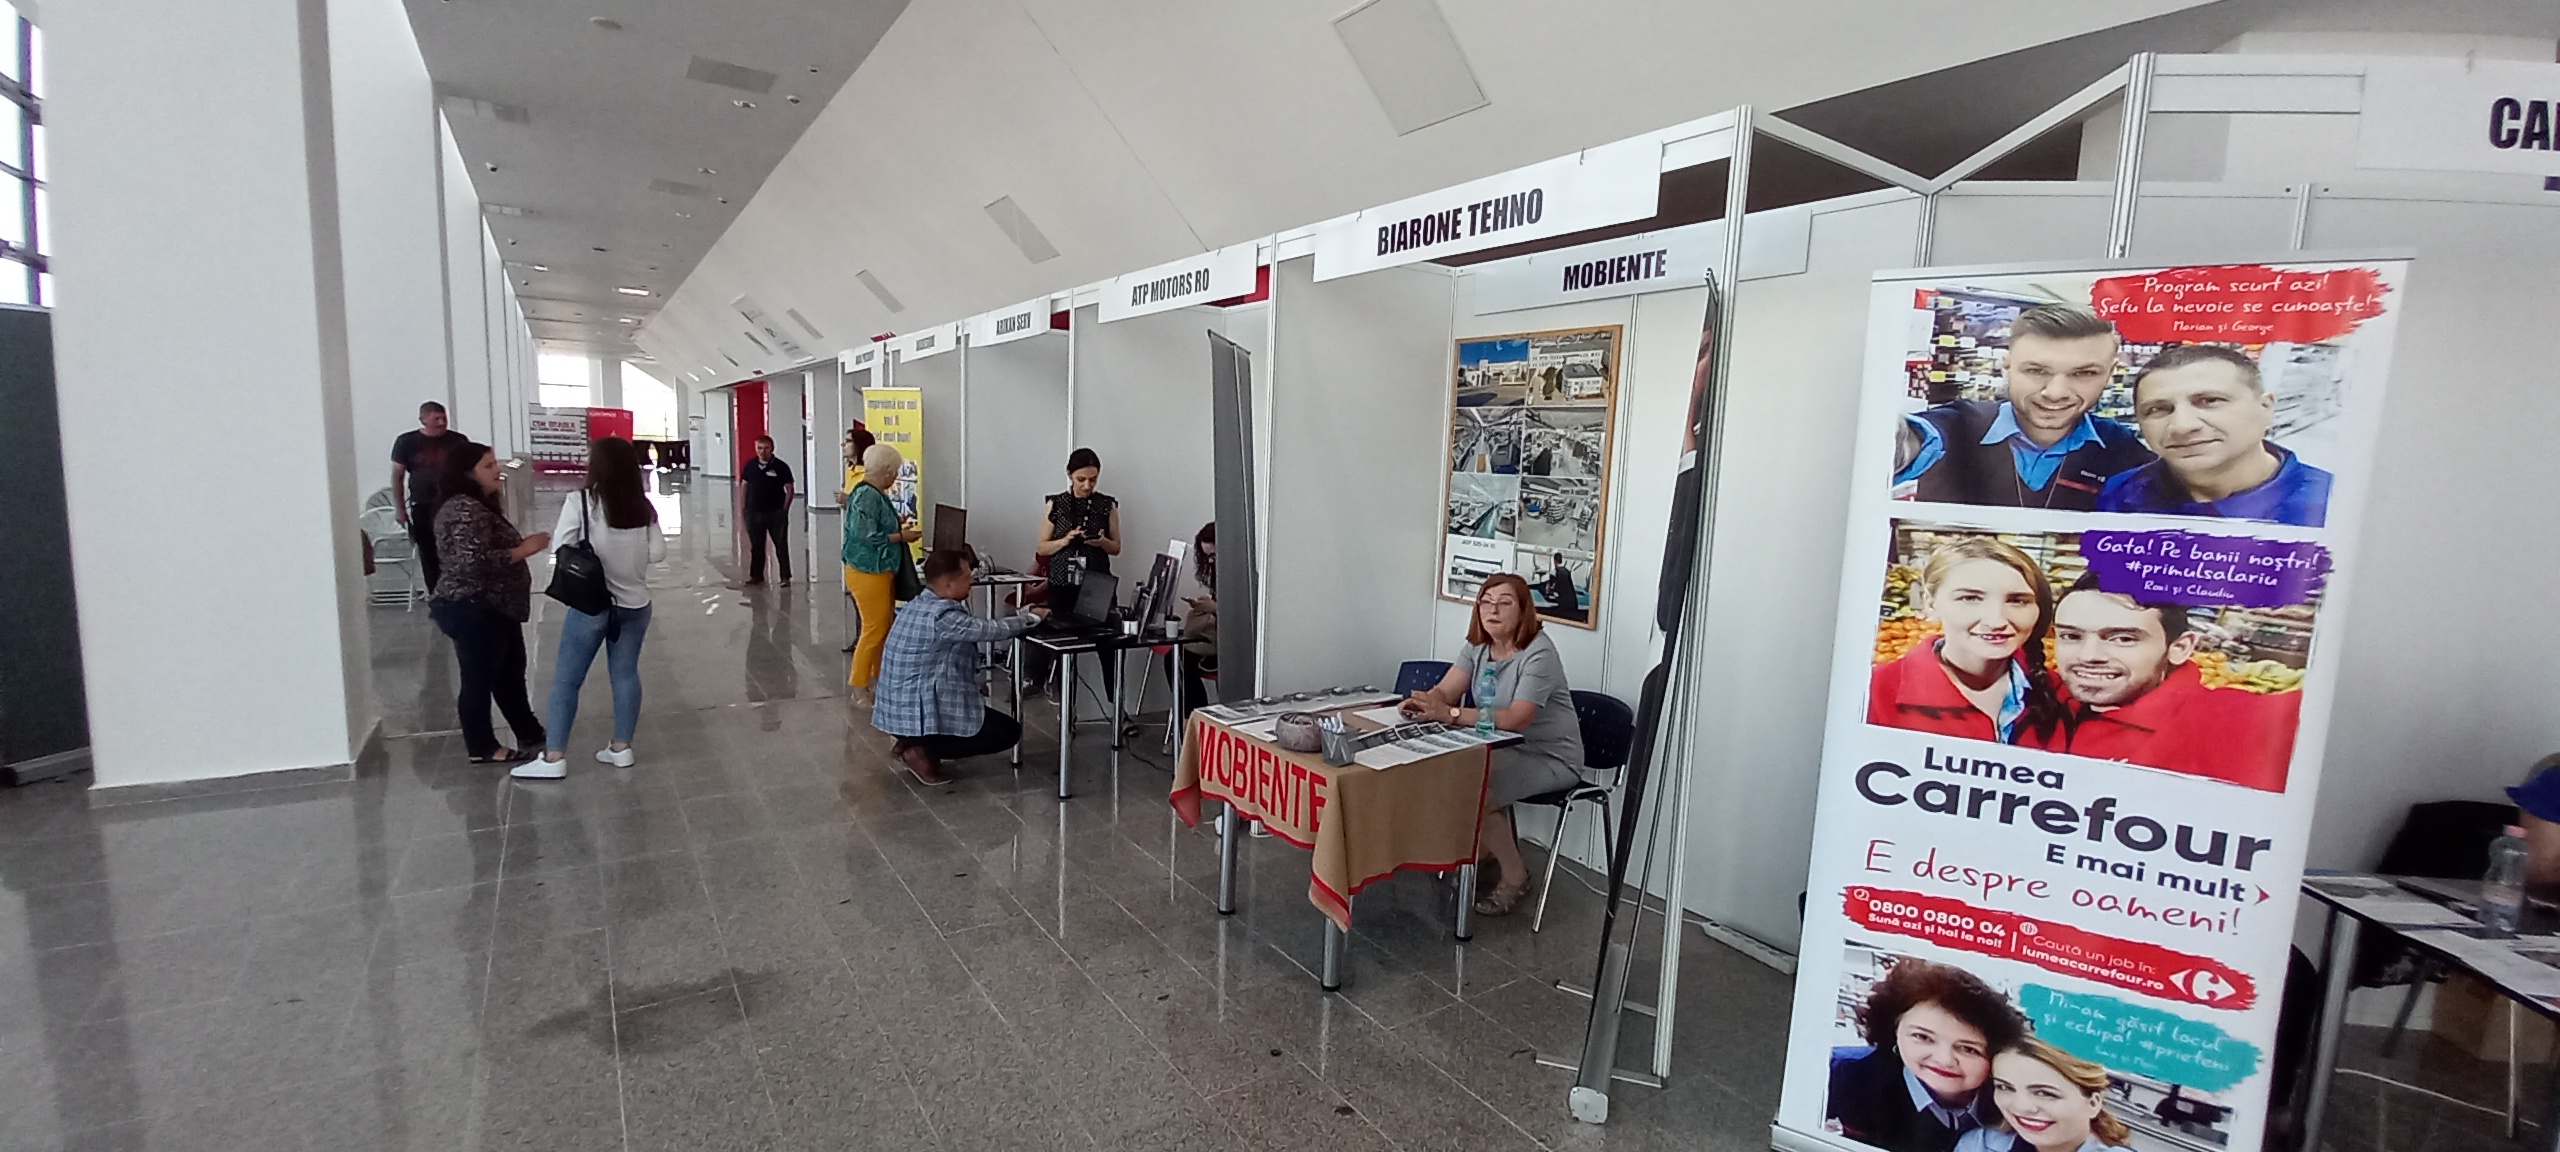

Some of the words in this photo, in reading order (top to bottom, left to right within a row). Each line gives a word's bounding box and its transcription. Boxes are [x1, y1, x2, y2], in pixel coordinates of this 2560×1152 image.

[2489, 97, 2560, 151] CA
[1377, 206, 1462, 258] BIARONE
[1468, 188, 1544, 237] TEHNO
[1131, 283, 1148, 307] ATP
[1150, 272, 1192, 303] MOTORS
[1195, 267, 1210, 295] RO
[1562, 249, 1667, 292] MOBIENTE
[2143, 277, 2221, 300] Program
[2229, 278, 2282, 292] scurt
[2290, 274, 2328, 292] azi!
[2146, 297, 2165, 313] la
[2173, 300, 2233, 314] nevoie
[2242, 301, 2262, 314] se
[2231, 320, 2274, 335] George
[2097, 536, 2154, 556] Gata!
[2160, 541, 2181, 558] Pe
[2190, 544, 2240, 563] banii
[2125, 560, 2278, 587] #primulsalariu
[2186, 584, 2234, 599] Claudiu
[1200, 720, 1328, 833] MOBIENTE
[1924, 747, 2065, 791] Lumea
[1855, 760, 2272, 872] Carrefour
[1864, 839, 1896, 874] E
[1912, 847, 2051, 902] despre
[2071, 888, 2240, 936] oameni!
[2045, 843, 2067, 865] E
[2076, 854, 2145, 882] mai
[2157, 871, 2247, 903] mult
[1868, 913, 1900, 926] Sună
[1937, 925, 1958, 938] hai
[1960, 930, 1974, 942] la
[1869, 900, 1918, 918] 0800
[1923, 909, 1975, 930] 0800
[1979, 921, 2006, 937] 04
[2022, 945, 2165, 990] lumeacarrefour.ro
[2033, 935, 2082, 956] Caută
[2086, 950, 2106, 962] un
[2108, 954, 2135, 969] job
